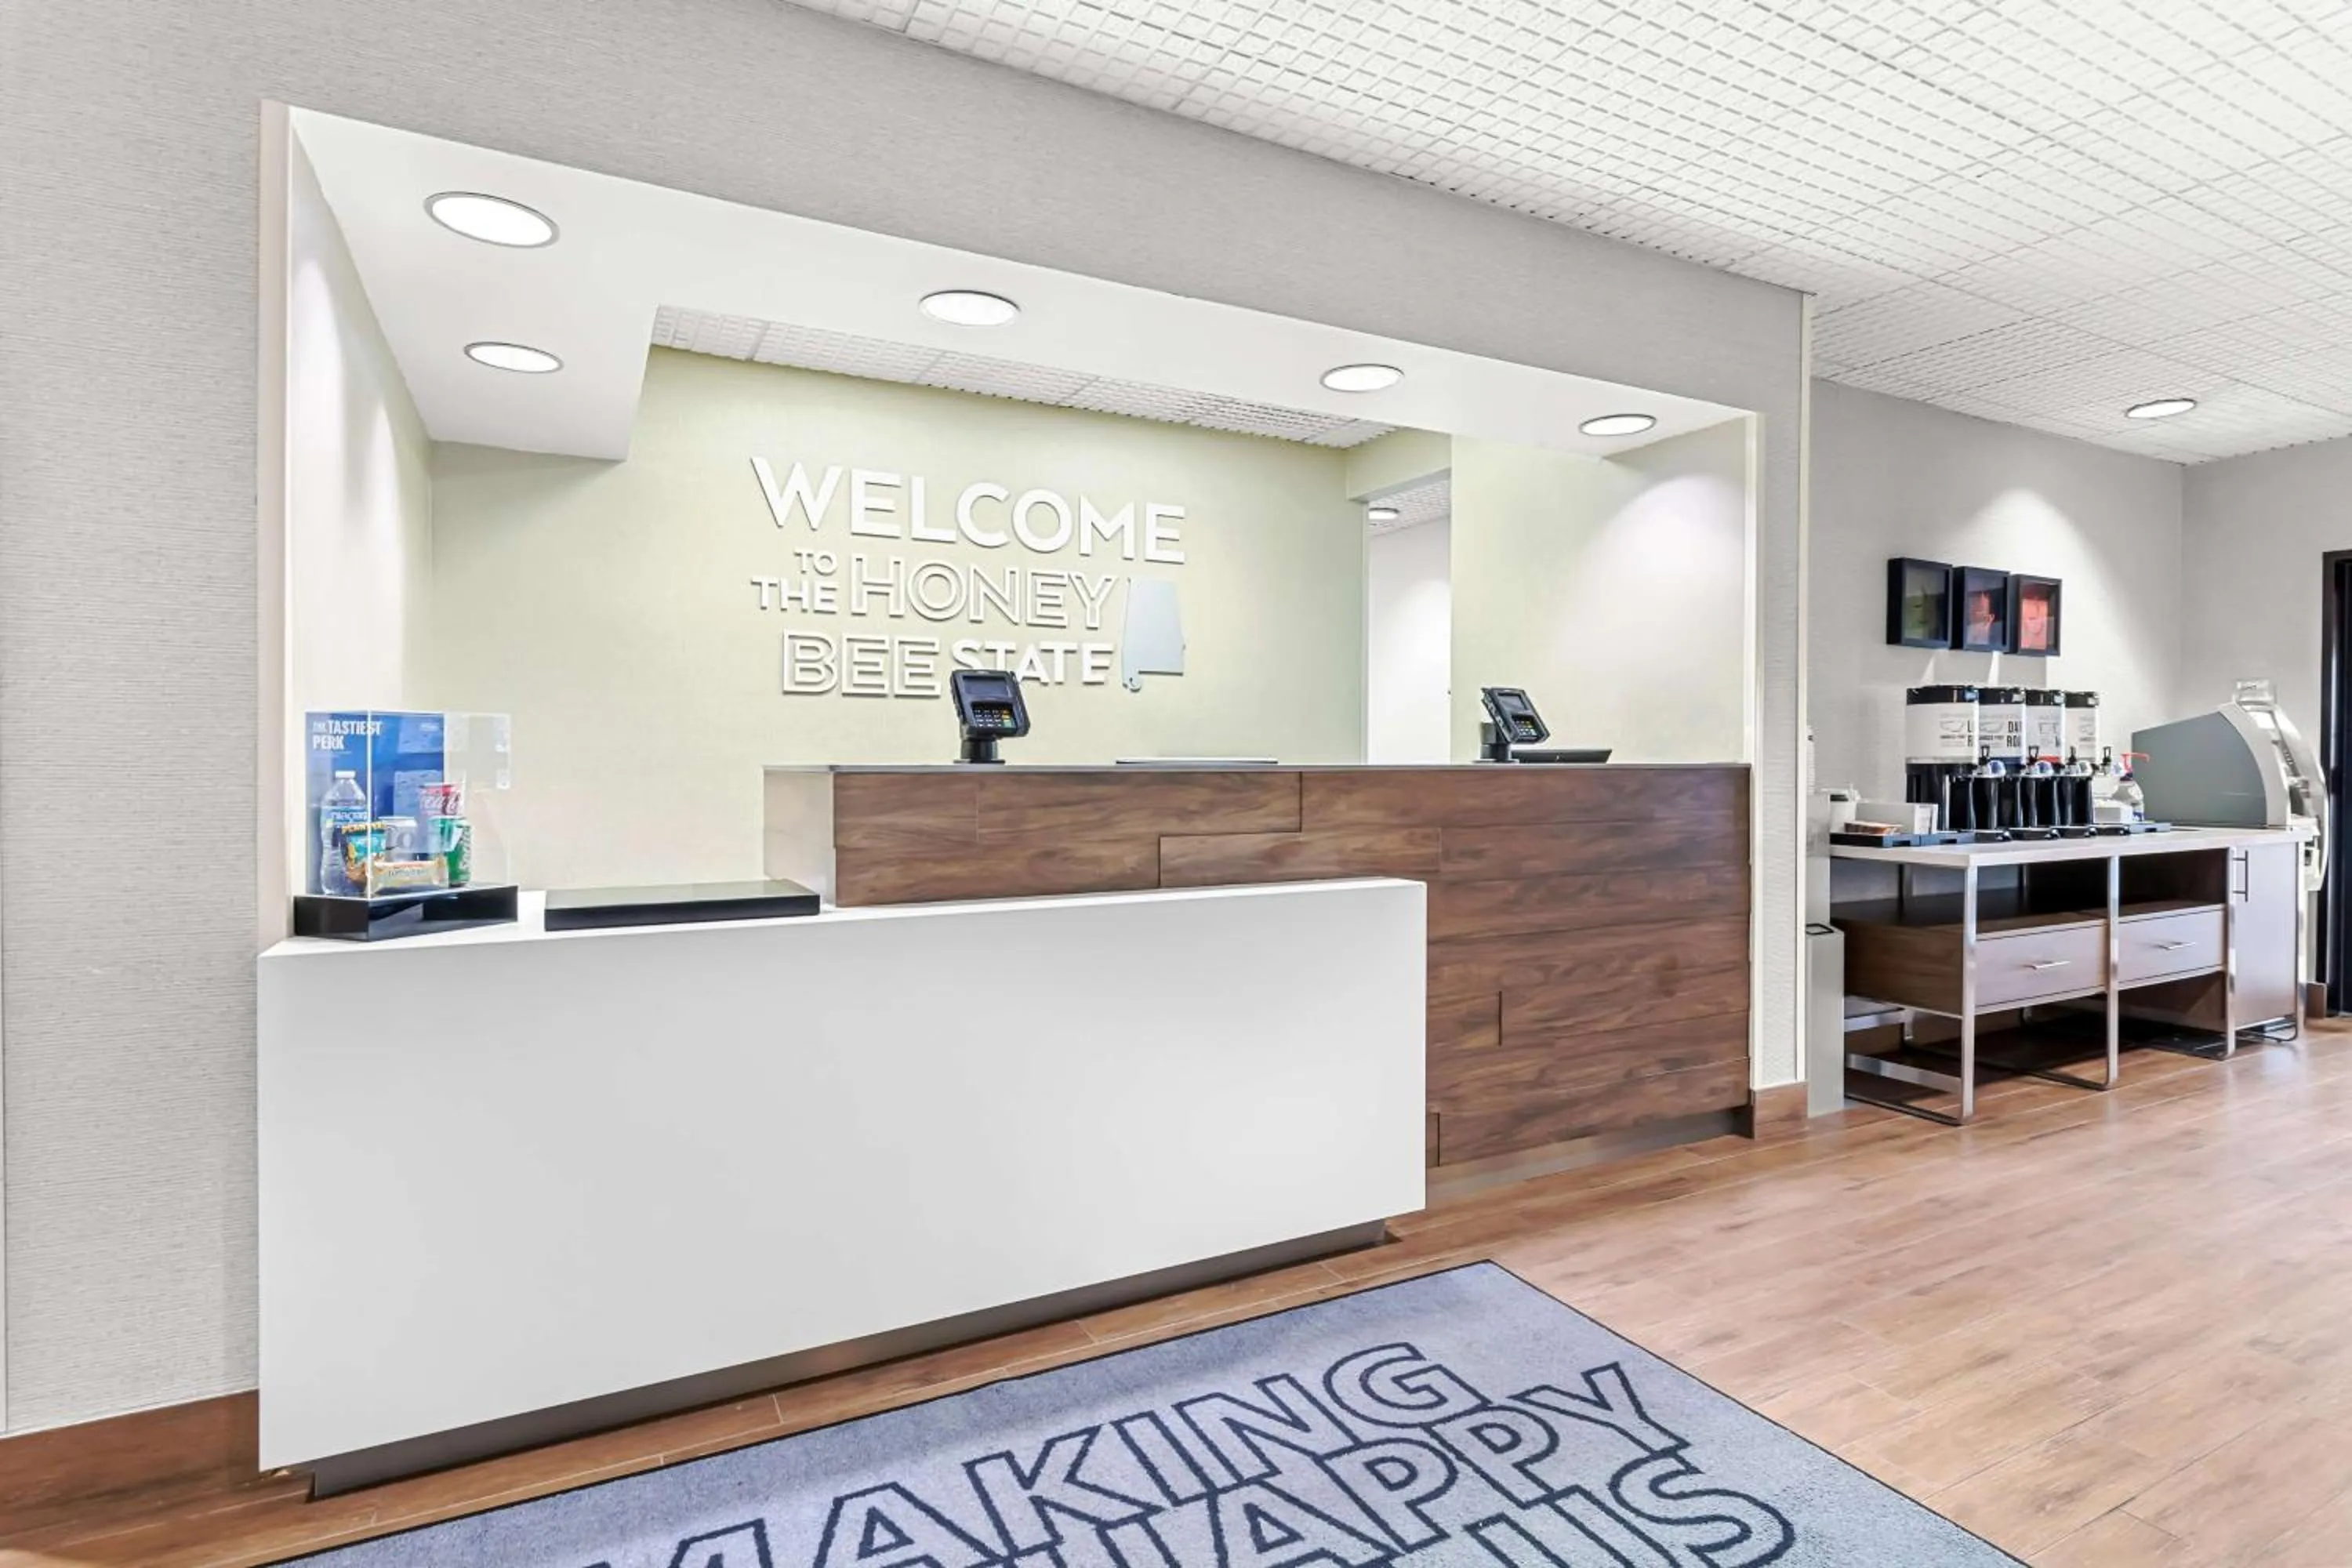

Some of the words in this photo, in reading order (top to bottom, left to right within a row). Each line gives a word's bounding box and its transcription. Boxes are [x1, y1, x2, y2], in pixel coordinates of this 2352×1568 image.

[750, 456, 1185, 564] WELCOME
[793, 550, 839, 576] TO
[750, 577, 840, 613] THE
[851, 554, 1120, 630] HONEY
[782, 629, 942, 699] BEE
[951, 639, 1115, 685] STATE
[313, 734, 345, 750] PERK
[326, 720, 382, 735] TASTIEST
